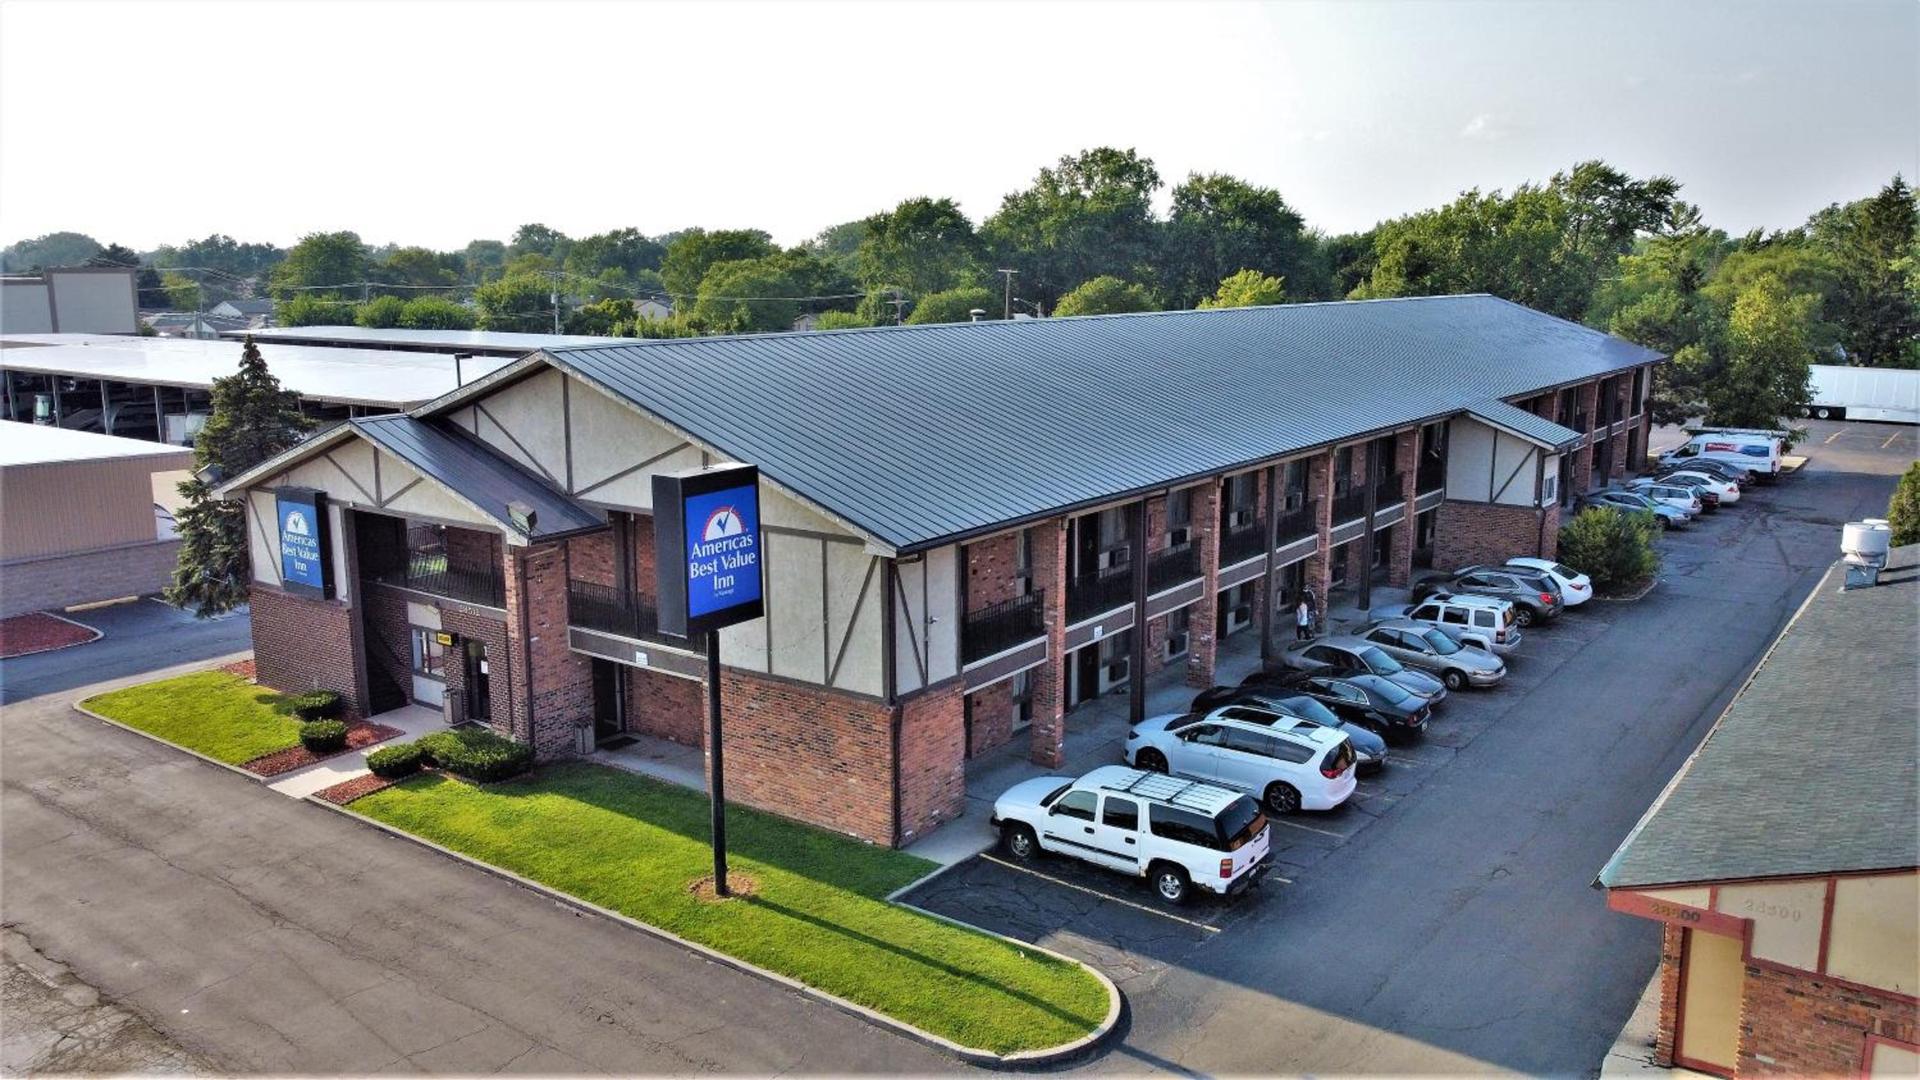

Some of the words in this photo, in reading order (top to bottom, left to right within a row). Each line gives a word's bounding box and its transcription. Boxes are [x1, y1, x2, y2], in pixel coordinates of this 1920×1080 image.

[691, 534, 753, 560] Americas
[690, 559, 718, 579] Best
[721, 550, 756, 570] Value
[713, 575, 734, 591] Inn
